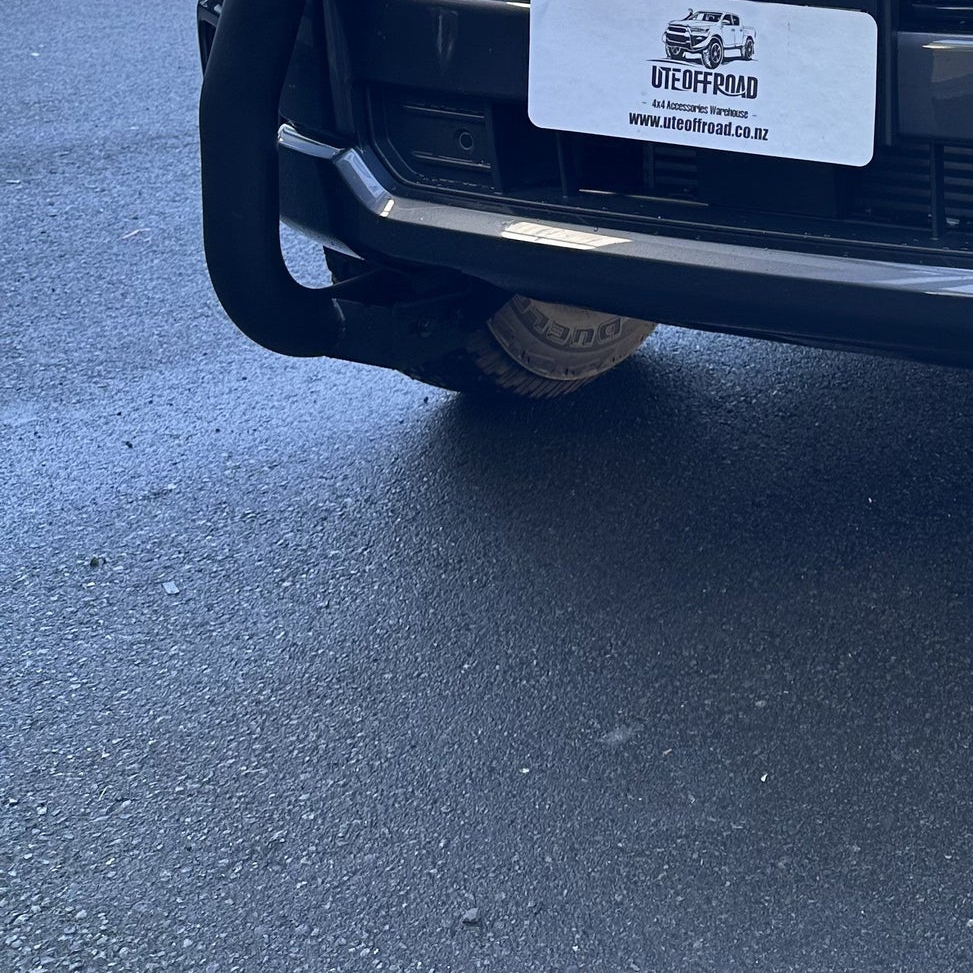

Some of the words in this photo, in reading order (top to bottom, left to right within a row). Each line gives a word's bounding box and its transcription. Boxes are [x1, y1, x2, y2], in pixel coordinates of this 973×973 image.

[651, 65, 758, 99] UTEOFFROAD
[652, 99, 665, 109] 4x4
[666, 100, 708, 115] Accessories
[710, 105, 749, 119] Warehouse
[629, 112, 769, 141] www.uteoffroad.co.nz
